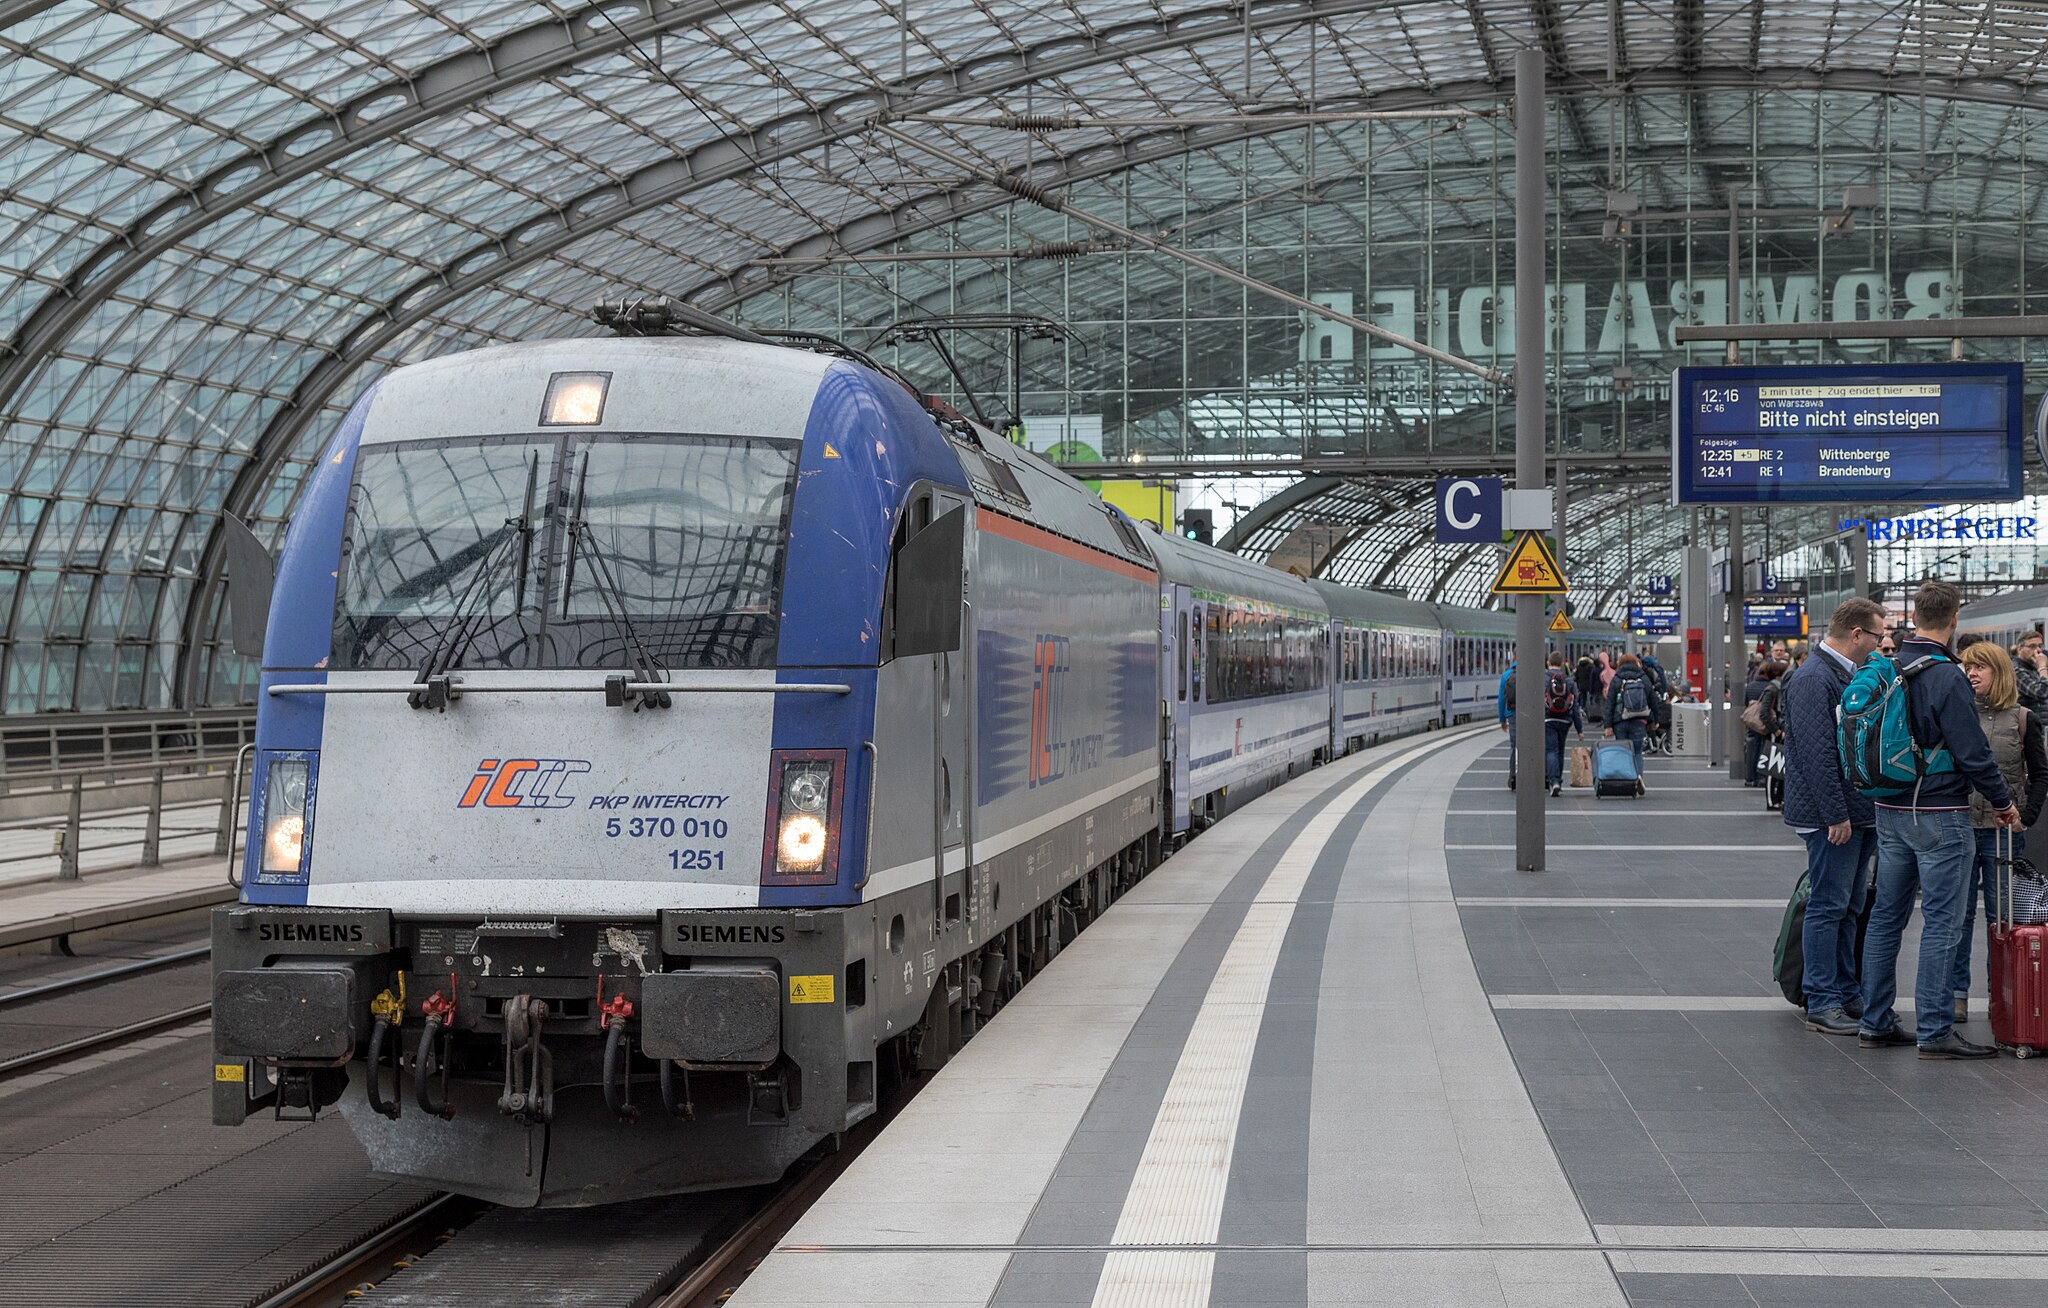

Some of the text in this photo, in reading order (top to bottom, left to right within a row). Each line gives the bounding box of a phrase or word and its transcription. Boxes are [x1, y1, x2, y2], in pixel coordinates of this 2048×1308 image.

[1701, 389, 1739, 403] 12:16
[1761, 388, 1767, 396] 5
[1770, 388, 1788, 396] min
[1790, 387, 1813, 396] late
[1827, 387, 1846, 397] Zug
[1849, 387, 1880, 396] endet
[1883, 386, 1903, 395] hier
[1701, 404, 1725, 413] EC 46
[1778, 400, 1824, 408] Warszawa
[1760, 409, 1940, 429] Bitte nicht einsteigen
[1700, 439, 1739, 447] Folgezüge:
[1701, 450, 1733, 461] 12:25
[1760, 450, 1774, 460] RE
[1776, 450, 1784, 460] 2
[1819, 448, 1890, 462] Wittenberge
[1701, 465, 1891, 479] 12:41 RE 1 Brandenburg
[1444, 480, 1482, 530] C
[1651, 576, 1667, 590] 14
[1676, 721, 1685, 751] Abfall
[588, 795, 731, 810] PKP INTERCITY
[605, 817, 728, 838] 5 370 010
[668, 849, 725, 870] 1251
[259, 923, 363, 942] SIEMENS
[677, 924, 785, 943] SIEMENS
